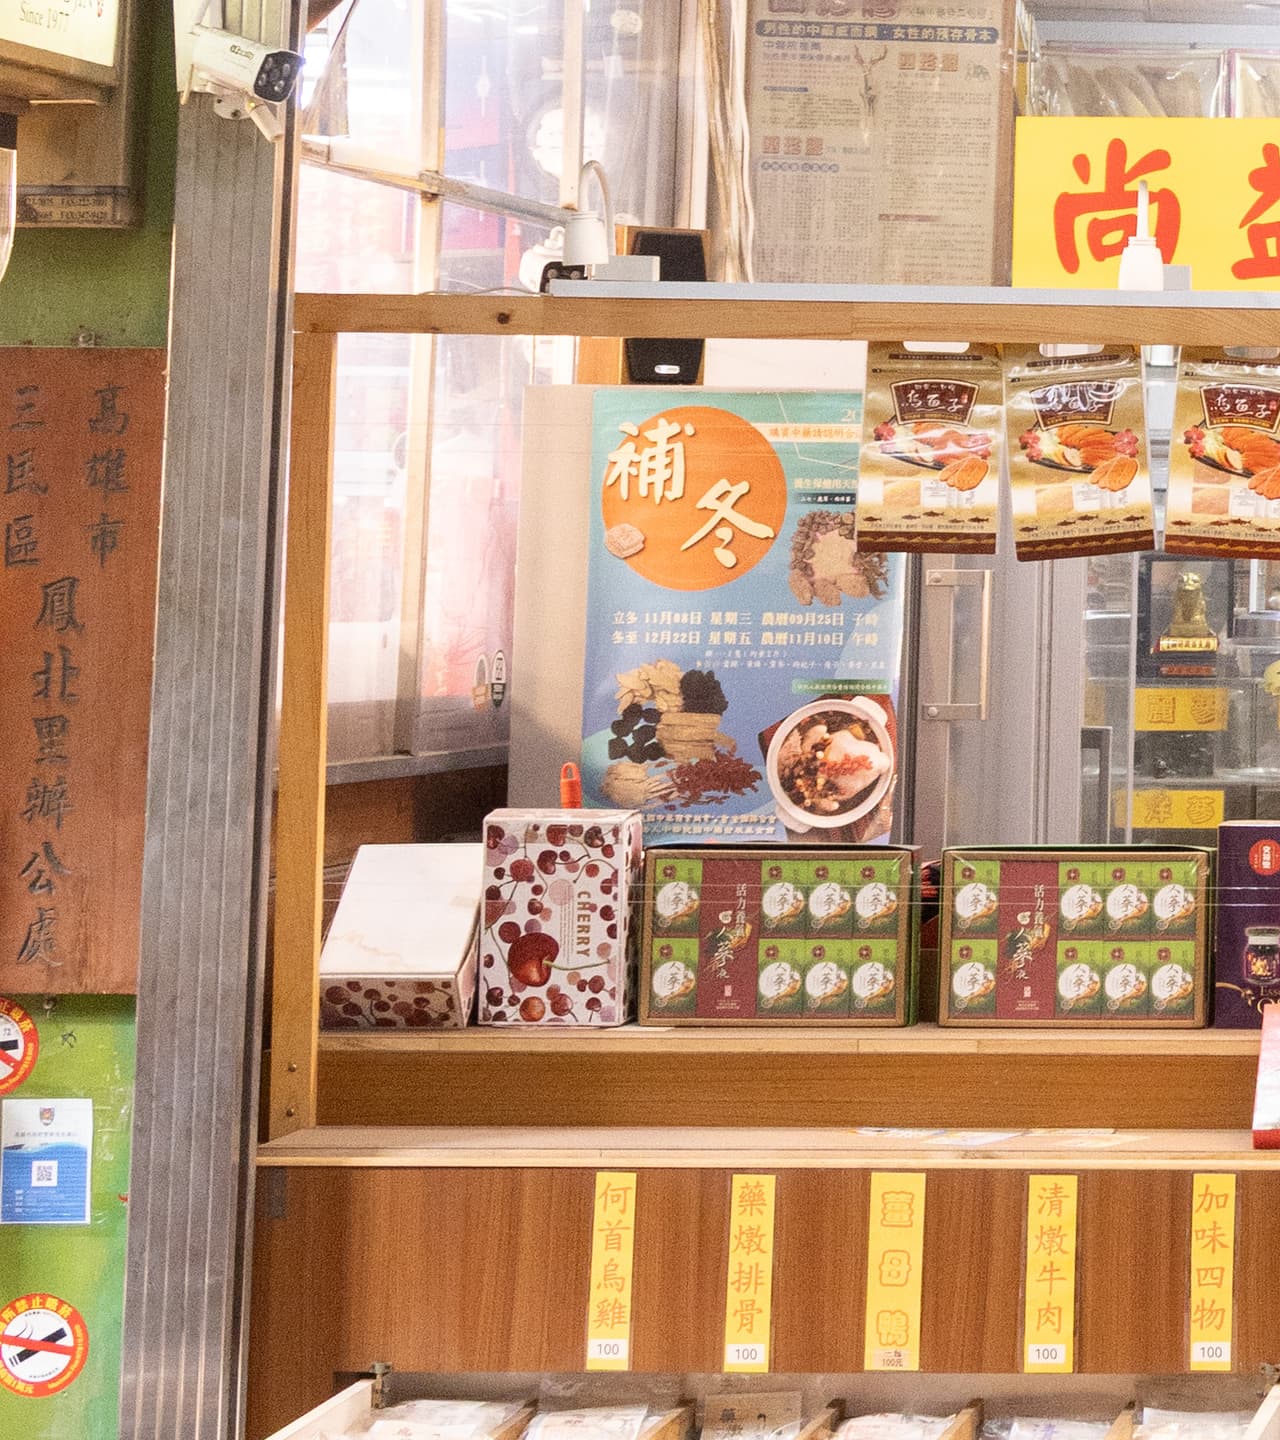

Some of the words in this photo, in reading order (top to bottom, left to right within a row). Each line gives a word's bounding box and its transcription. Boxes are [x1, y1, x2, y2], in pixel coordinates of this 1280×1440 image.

[3, 384, 50, 570] 三民區
[85, 382, 130, 569] 高雄市
[16, 576, 86, 968] 鳳北里辦公處
[577, 890, 591, 958] CHERRY
[594, 1183, 629, 1330] 何首烏雞
[731, 1182, 770, 1334] 藥燉排骨
[877, 1189, 917, 1348] 薑母鴨
[1035, 1183, 1072, 1336] 清燉牛肉
[1193, 1183, 1229, 1332] 加味四物
[597, 1342, 621, 1357] 100
[734, 1346, 759, 1361] 100
[1034, 1346, 1059, 1361] 100
[1199, 1345, 1224, 1360] 100
